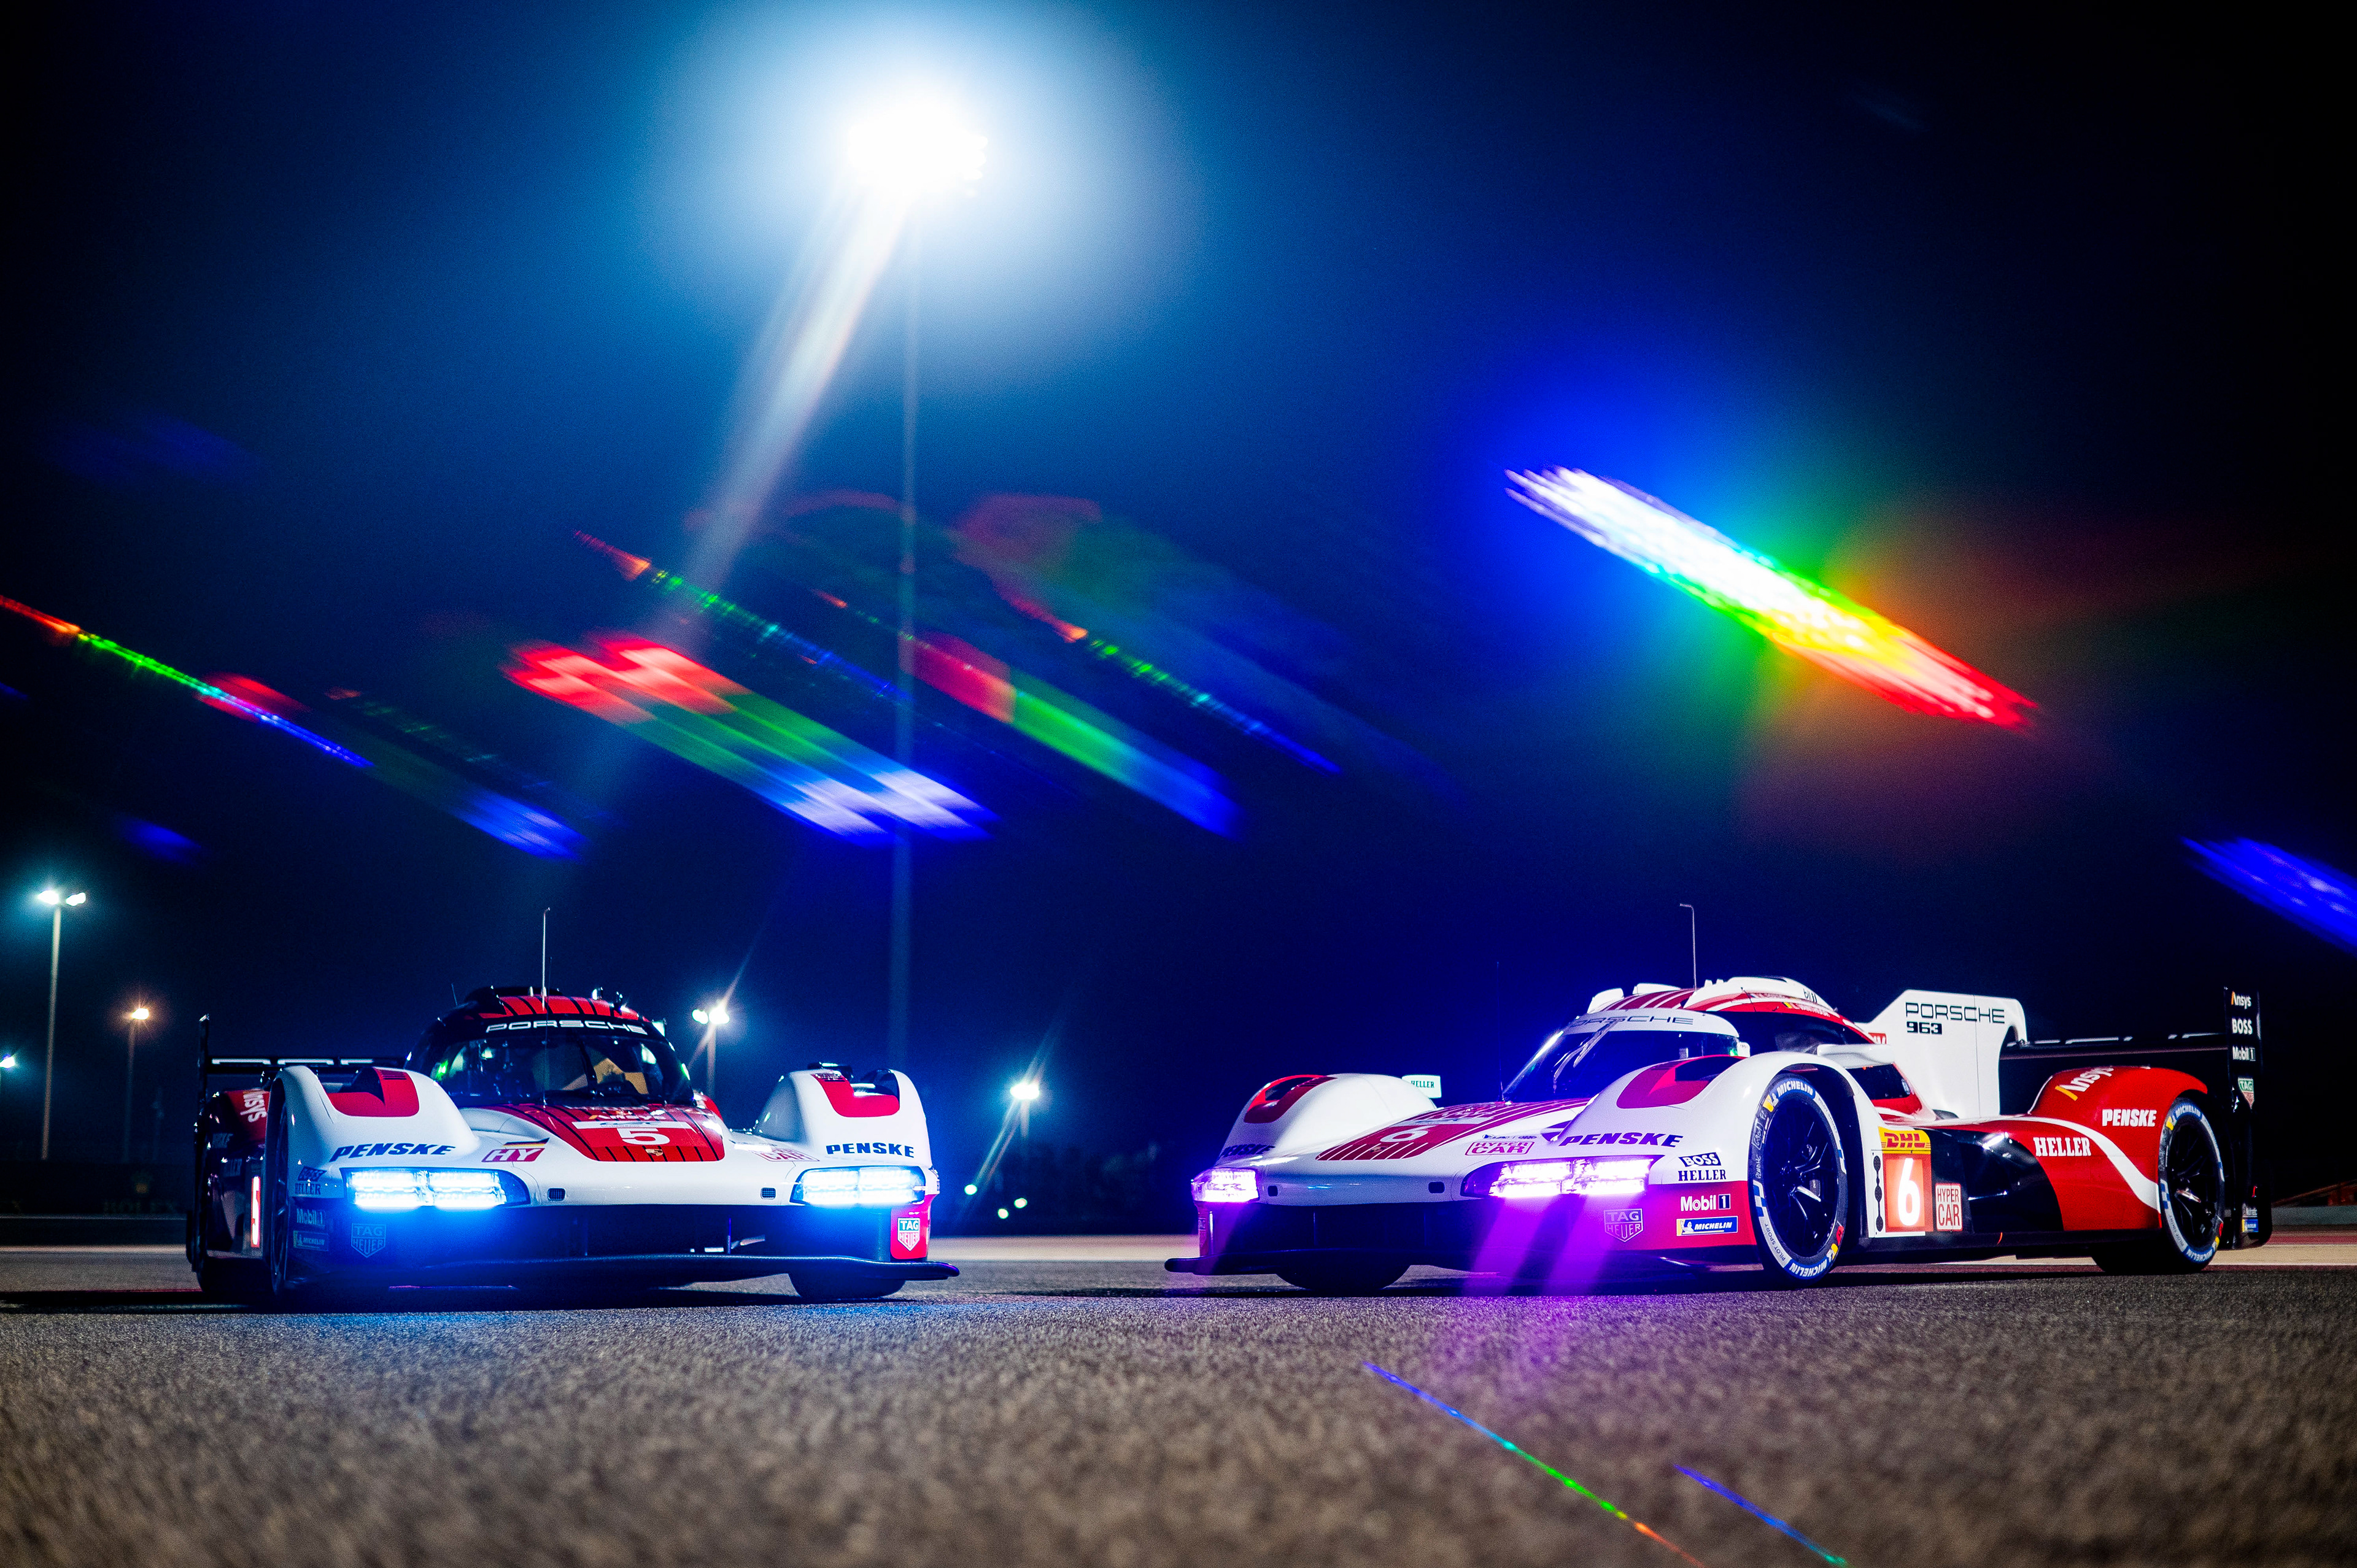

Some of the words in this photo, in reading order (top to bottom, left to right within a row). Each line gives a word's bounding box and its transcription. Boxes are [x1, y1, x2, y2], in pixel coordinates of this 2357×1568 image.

[2231, 991, 2251, 1009] Ansys
[1905, 1002, 2005, 1024] PORSCHE
[486, 1019, 648, 1035] PORSCHE
[1570, 1016, 1694, 1027] ORSCHE
[1906, 1021, 1943, 1035] 963
[2232, 1018, 2253, 1035] BOSS
[2232, 1046, 2249, 1060] Mobil
[1776, 1081, 1813, 1098] MICHELIN
[2054, 1066, 2115, 1101] Ansys
[2240, 1081, 2253, 1091] TAG
[2102, 1108, 2158, 1127] PENSKE
[616, 1127, 670, 1146] 5
[1379, 1125, 1439, 1143] 6
[1558, 1132, 1684, 1148] PENSKE
[1884, 1132, 1925, 1148] DHL
[328, 1143, 457, 1162] PENSKE
[484, 1148, 540, 1162] HY
[826, 1142, 915, 1159] PENSKE
[2033, 1137, 2092, 1157] HELLER
[1682, 1154, 1719, 1165] BOSS
[1678, 1169, 1727, 1181] HELLER
[1898, 1157, 1921, 1226] 6
[1937, 1188, 1959, 1202] HYPER
[1681, 1194, 1716, 1211] Mobil
[296, 1208, 317, 1225] Mobil
[1607, 1211, 1639, 1222] TAG
[1938, 1203, 1960, 1226] CAR
[354, 1226, 383, 1236] TAG
[900, 1220, 919, 1230] TAG
[1607, 1224, 1641, 1240] HEUER
[1694, 1222, 1733, 1230] MICHELIN
[899, 1232, 919, 1248] HEUER
[1764, 1223, 1776, 1245] SPORT
[353, 1238, 384, 1254] HEUER
[1774, 1246, 1786, 1261] PILOT
[1789, 1259, 1827, 1277] MICHELIN
